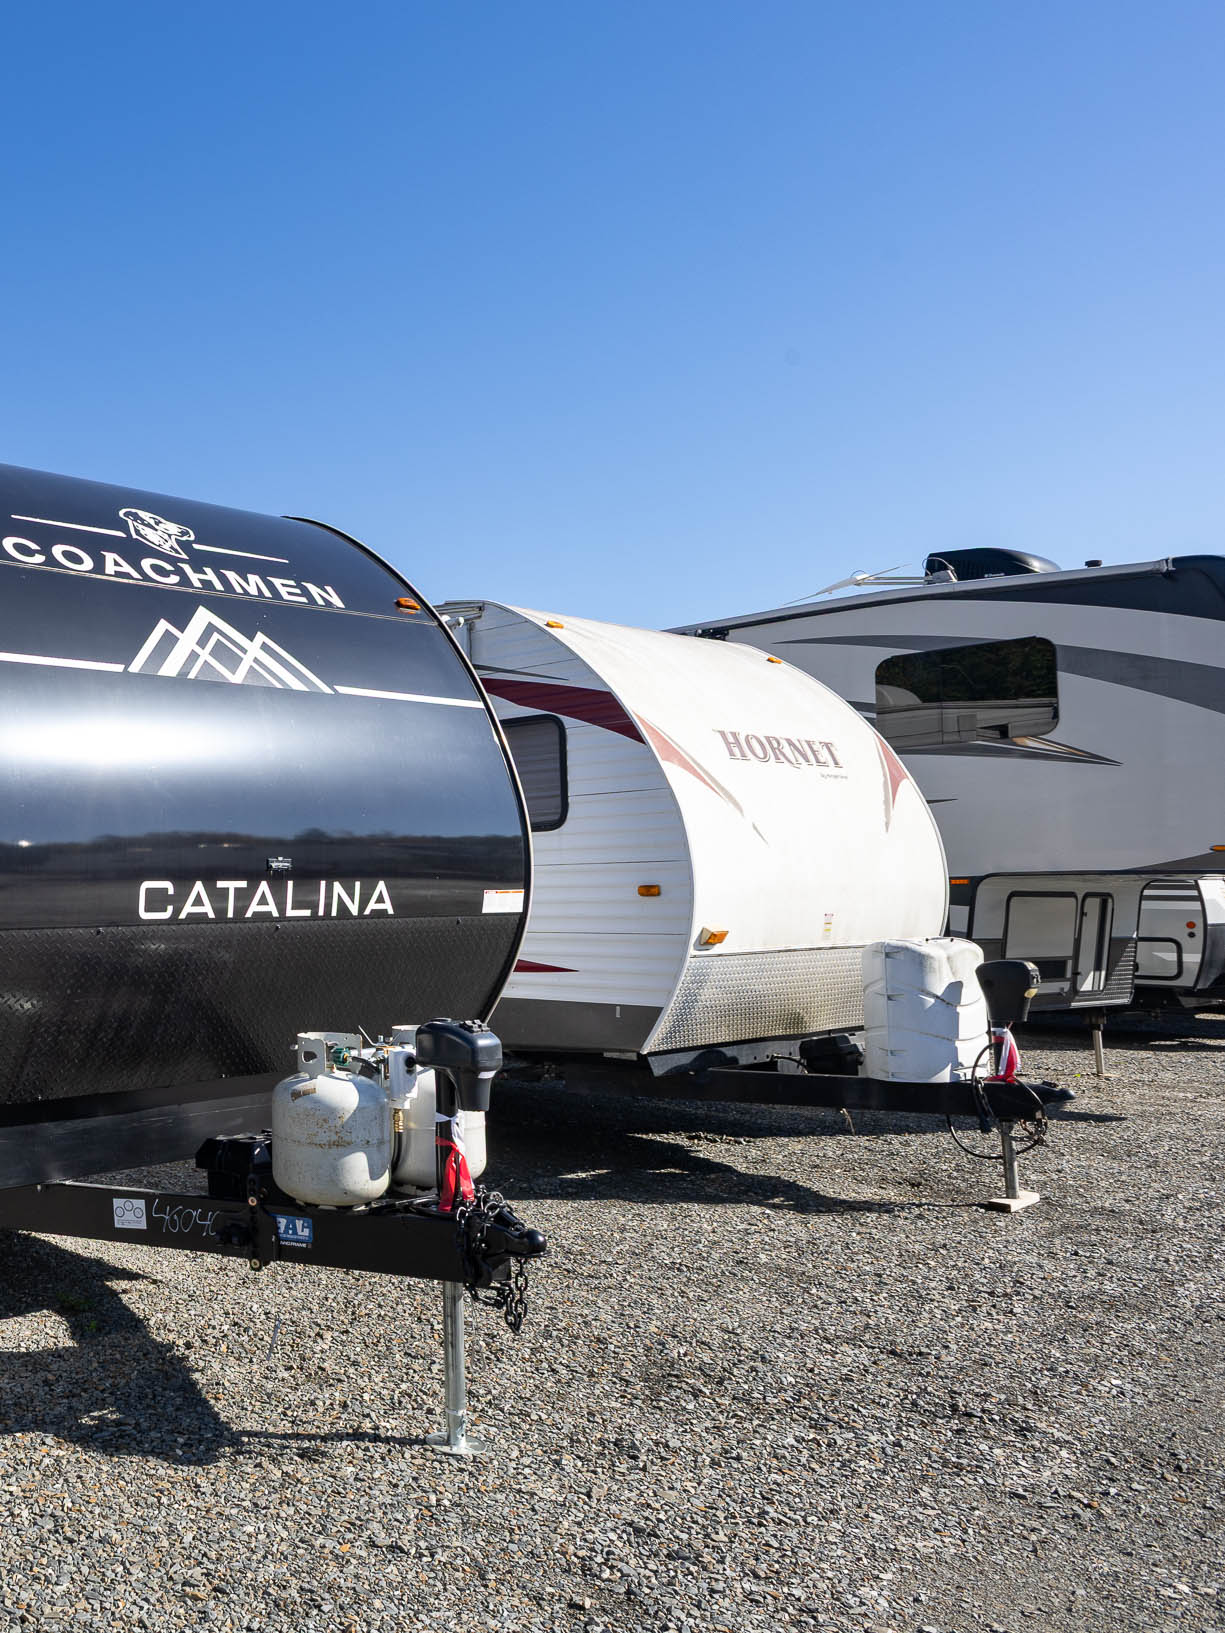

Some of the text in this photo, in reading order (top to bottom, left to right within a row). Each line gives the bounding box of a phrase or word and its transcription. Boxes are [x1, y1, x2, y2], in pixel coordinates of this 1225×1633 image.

[1, 536, 346, 609] COACHMEN
[712, 728, 843, 769] HORNET
[138, 880, 395, 920] CATALINA
